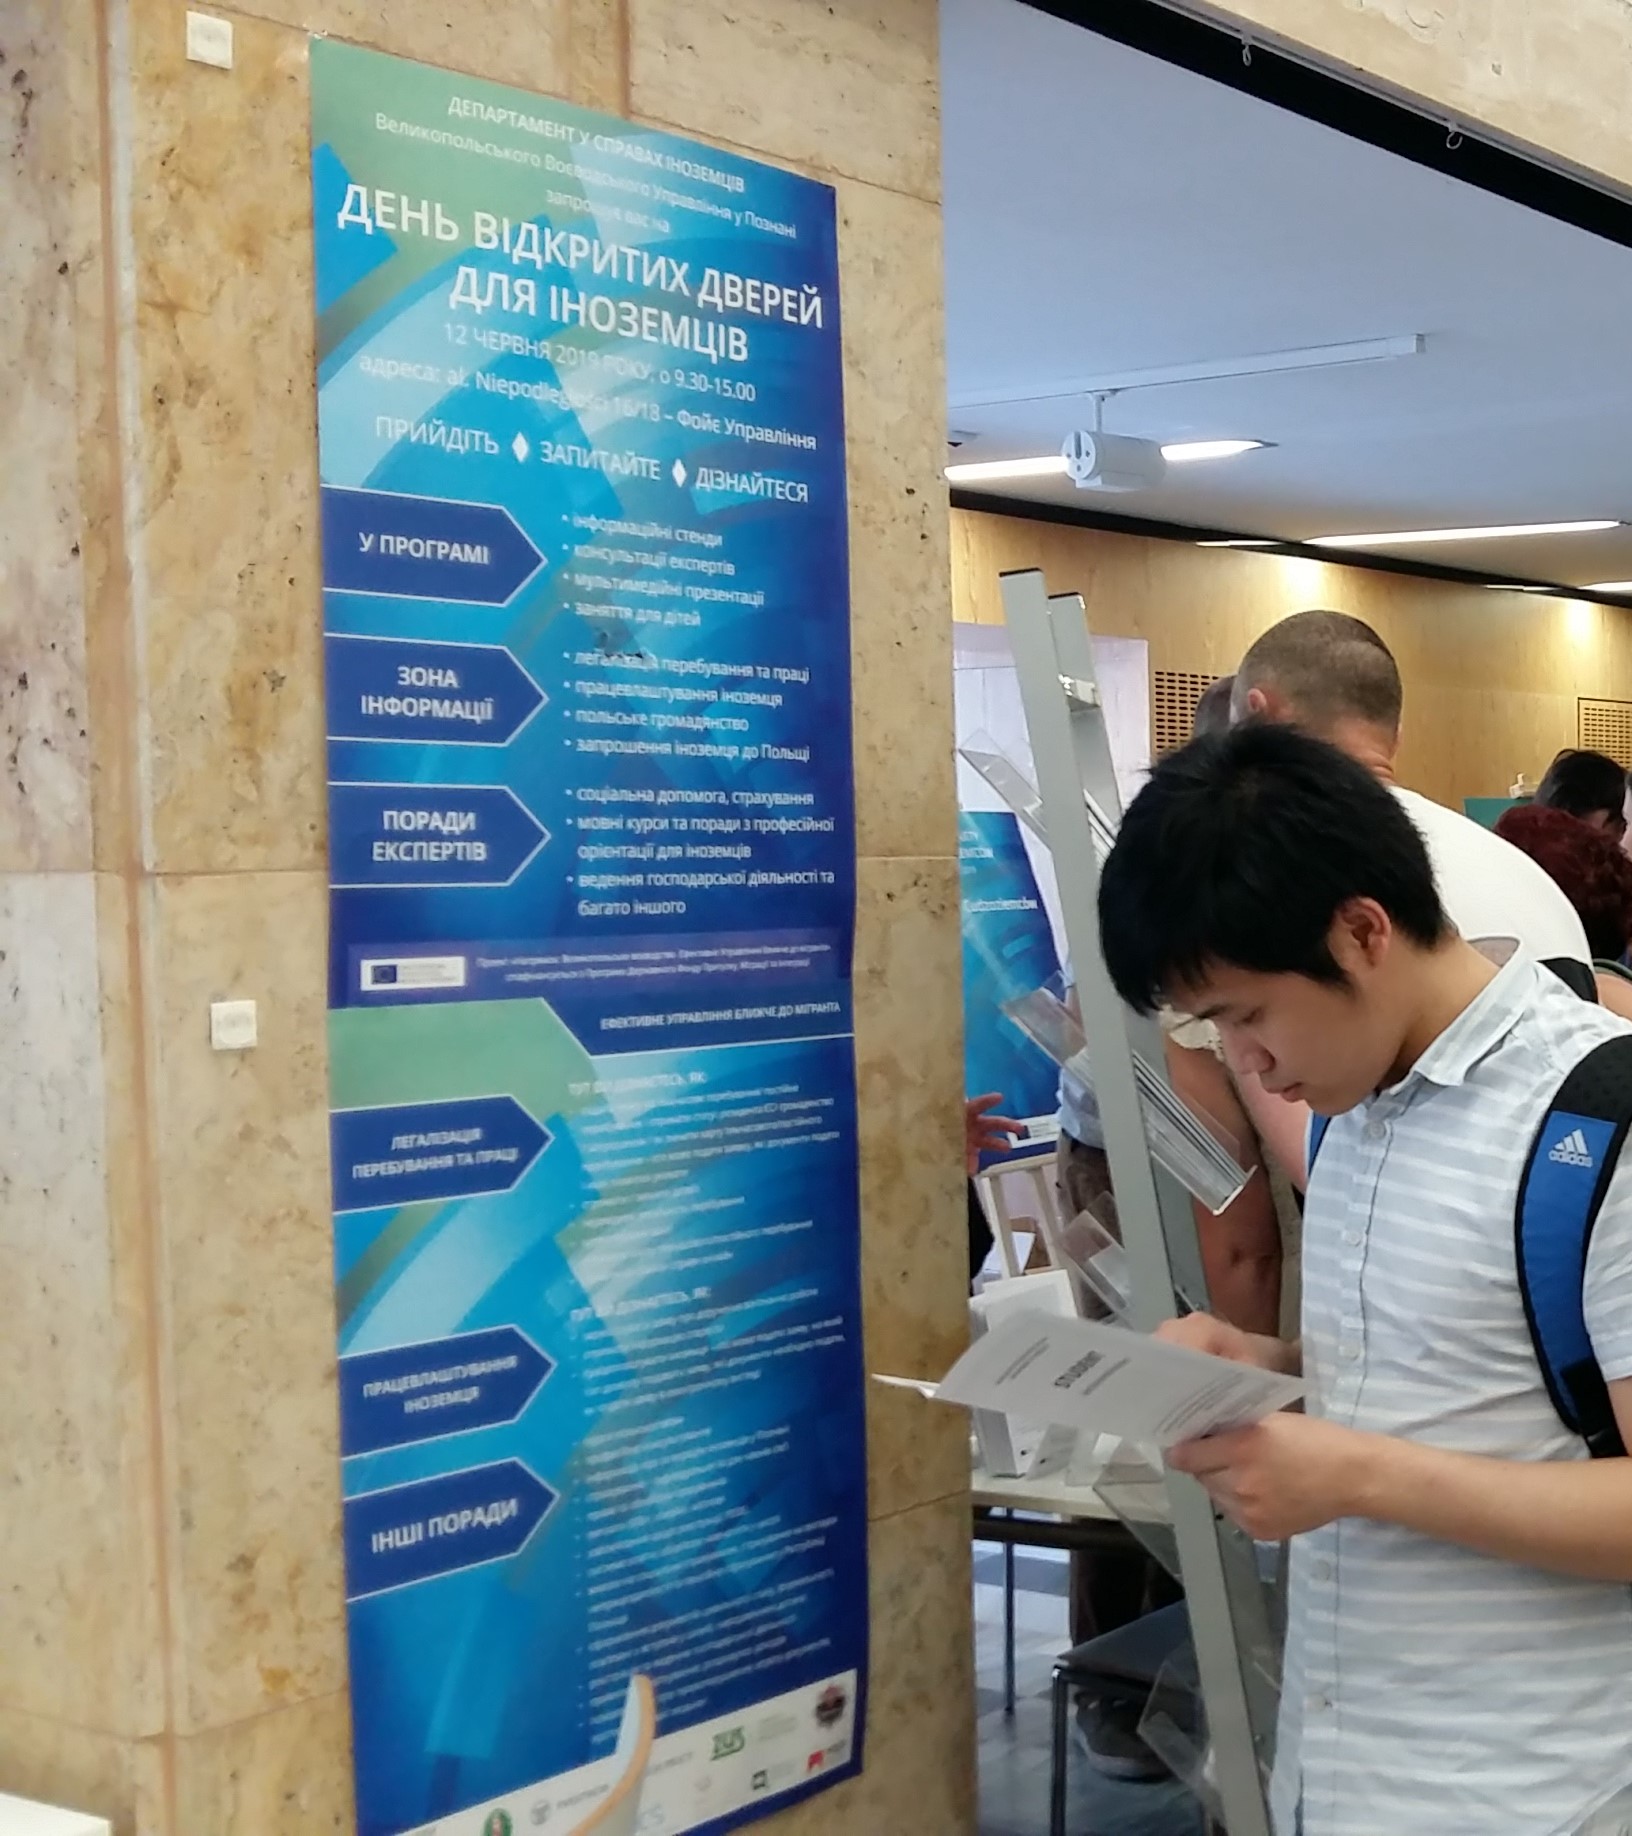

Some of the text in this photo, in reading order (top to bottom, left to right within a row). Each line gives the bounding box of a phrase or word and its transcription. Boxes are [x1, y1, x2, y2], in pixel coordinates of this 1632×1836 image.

[448, 96, 745, 193] ДЕПАРТАМЕНТ У СПРАВАХ ІНОЗЕМЦІВ
[375, 112, 541, 167] Великопольського
[734, 212, 743, 227] у
[744, 210, 797, 239] Познані
[337, 183, 823, 329] ДЕНЬ ВІДКРИТИХ ДВЕРЕЙ
[449, 265, 749, 365] ДЛЯ ІНОЗЕМЦІВ
[444, 322, 467, 345] 12
[474, 327, 550, 361] ЧЕРВНЯ
[674, 368, 757, 402] 9.30-15.00
[359, 354, 441, 384] адреса:
[676, 409, 722, 434] Фойє
[724, 417, 818, 450] Управління
[376, 415, 809, 503] ПРИЙДІТЬ ЗАПИТАЙТЕ ДІЗНАЙТЕСЯ
[573, 514, 722, 548] інформаційні стенди
[359, 531, 491, 566] У ПРОГРАМІ
[574, 544, 736, 577] консультації експертів
[574, 573, 764, 608] мультимедійні презентації
[574, 602, 701, 626] заняття для дітей
[397, 665, 460, 689] ЗОНА
[661, 657, 754, 679] перебування
[756, 662, 770, 680] та
[773, 666, 811, 685] праці
[575, 680, 783, 709] працевлаштування іноземця
[361, 695, 495, 725] ІНФОРМАЦІЇ
[575, 708, 749, 733] польське громадянство
[575, 738, 811, 764] запрошення іноземця до Польщі
[576, 786, 656, 805] соціальна
[731, 790, 815, 809] страхування
[382, 810, 477, 836] ПОРАДИ
[577, 814, 624, 831] мовні
[626, 818, 670, 835] курси
[672, 818, 689, 832] та
[690, 818, 741, 836] поради
[754, 815, 835, 836] професійної
[372, 840, 488, 862] ЕКСПЕРТІВ
[576, 842, 753, 863] орієнтації для іноземців
[578, 868, 836, 890] ведення господарської діяльності та
[577, 898, 687, 917] багато іншого
[600, 1016, 666, 1031] ЕФЕКТИВНЕ
[352, 1153, 455, 1180] ПЕРЕБУВАННЯ
[456, 1150, 474, 1166] ТА
[1548, 1149, 1593, 1169] adidas
[371, 1497, 519, 1554] ІНШІ ПОРАДИ
